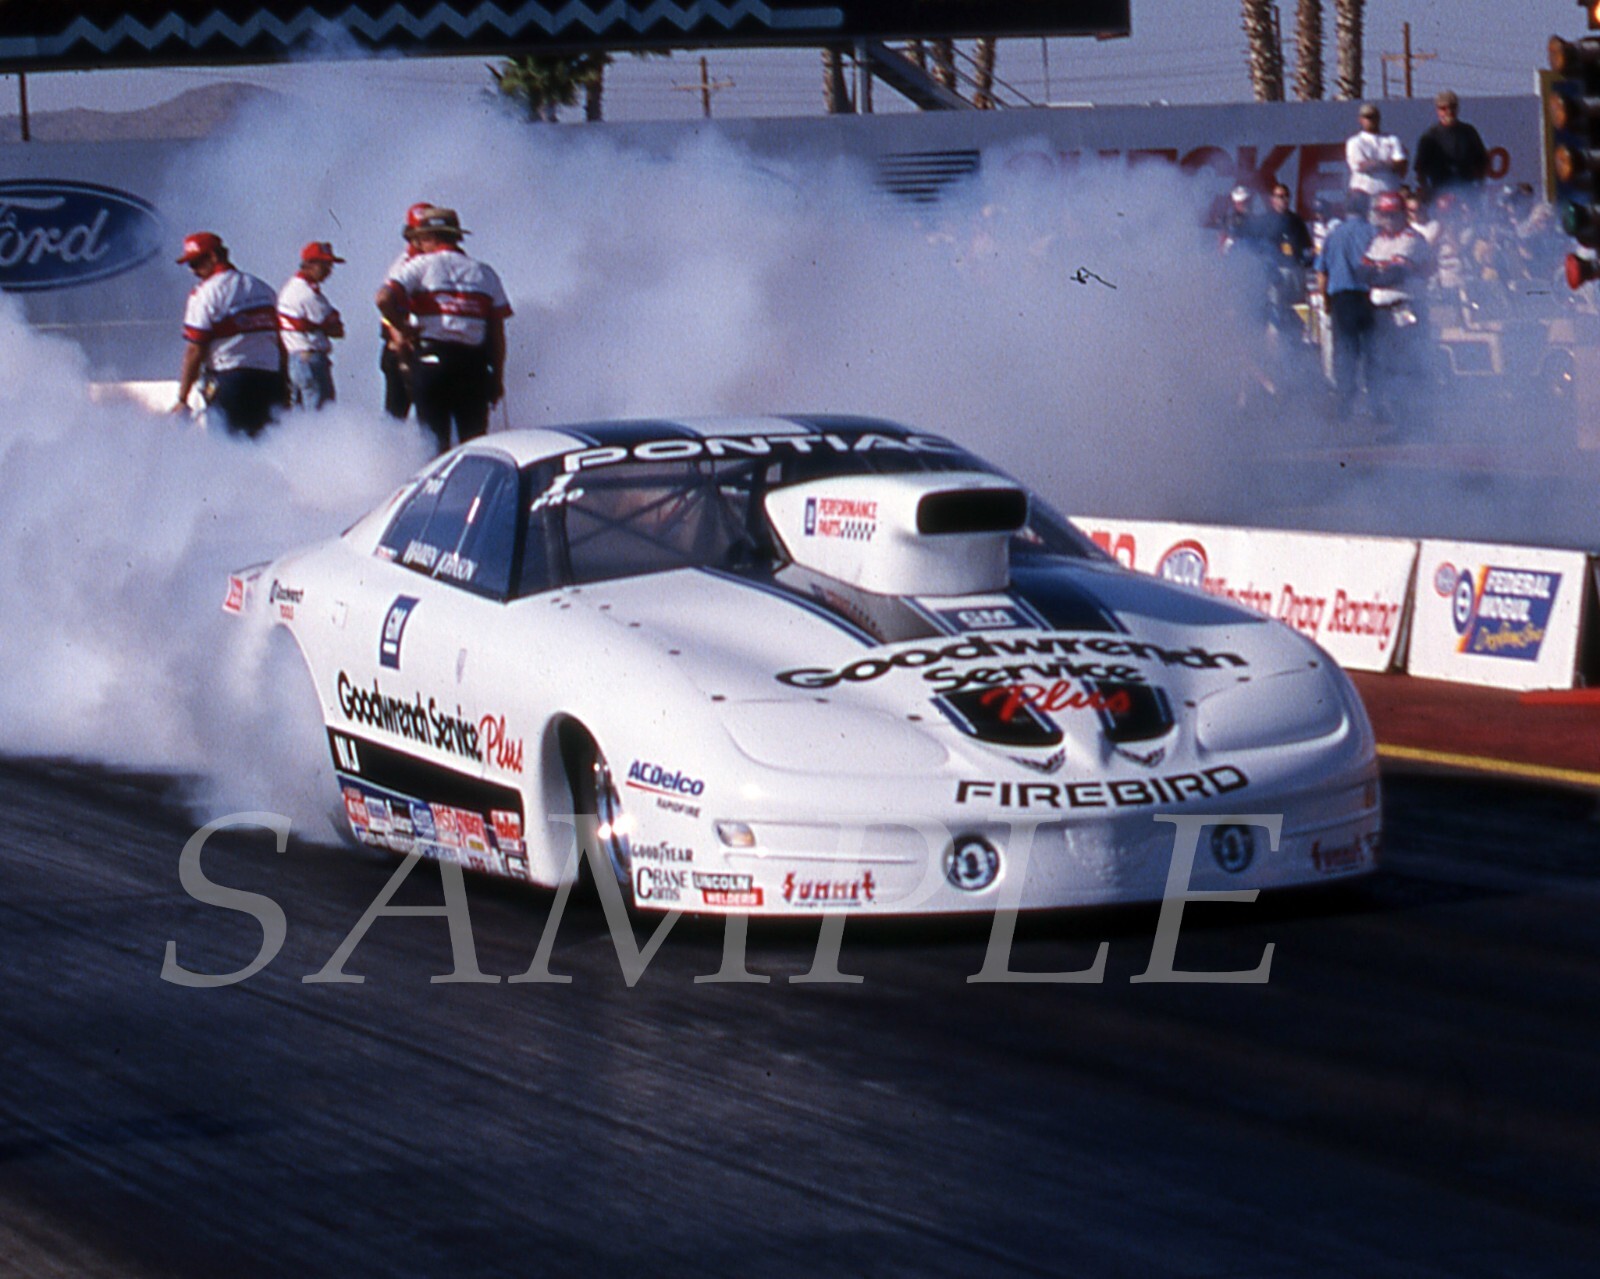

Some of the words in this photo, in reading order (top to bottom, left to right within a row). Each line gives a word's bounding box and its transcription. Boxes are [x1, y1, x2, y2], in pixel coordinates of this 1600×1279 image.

[563, 433, 961, 472] PONTIAC
[819, 498, 878, 519] PERFORMANCE
[818, 519, 841, 538] PARTS
[1485, 570, 1551, 598] FEDERAL
[1277, 583, 1327, 642] Drag
[1327, 588, 1399, 651] Racing
[1478, 594, 1531, 622] MOGUL
[775, 635, 1249, 689] Goodwrench
[922, 655, 1147, 693] Service
[981, 678, 1132, 723] Plus
[337, 669, 432, 746] Goodwrench
[428, 697, 483, 763] Service
[479, 713, 523, 774] Plus
[628, 759, 705, 797] ACDelco
[955, 764, 1249, 807] FIREBIRD
[631, 840, 694, 864] GOODYEAR
[695, 873, 751, 890] LINCOLN
